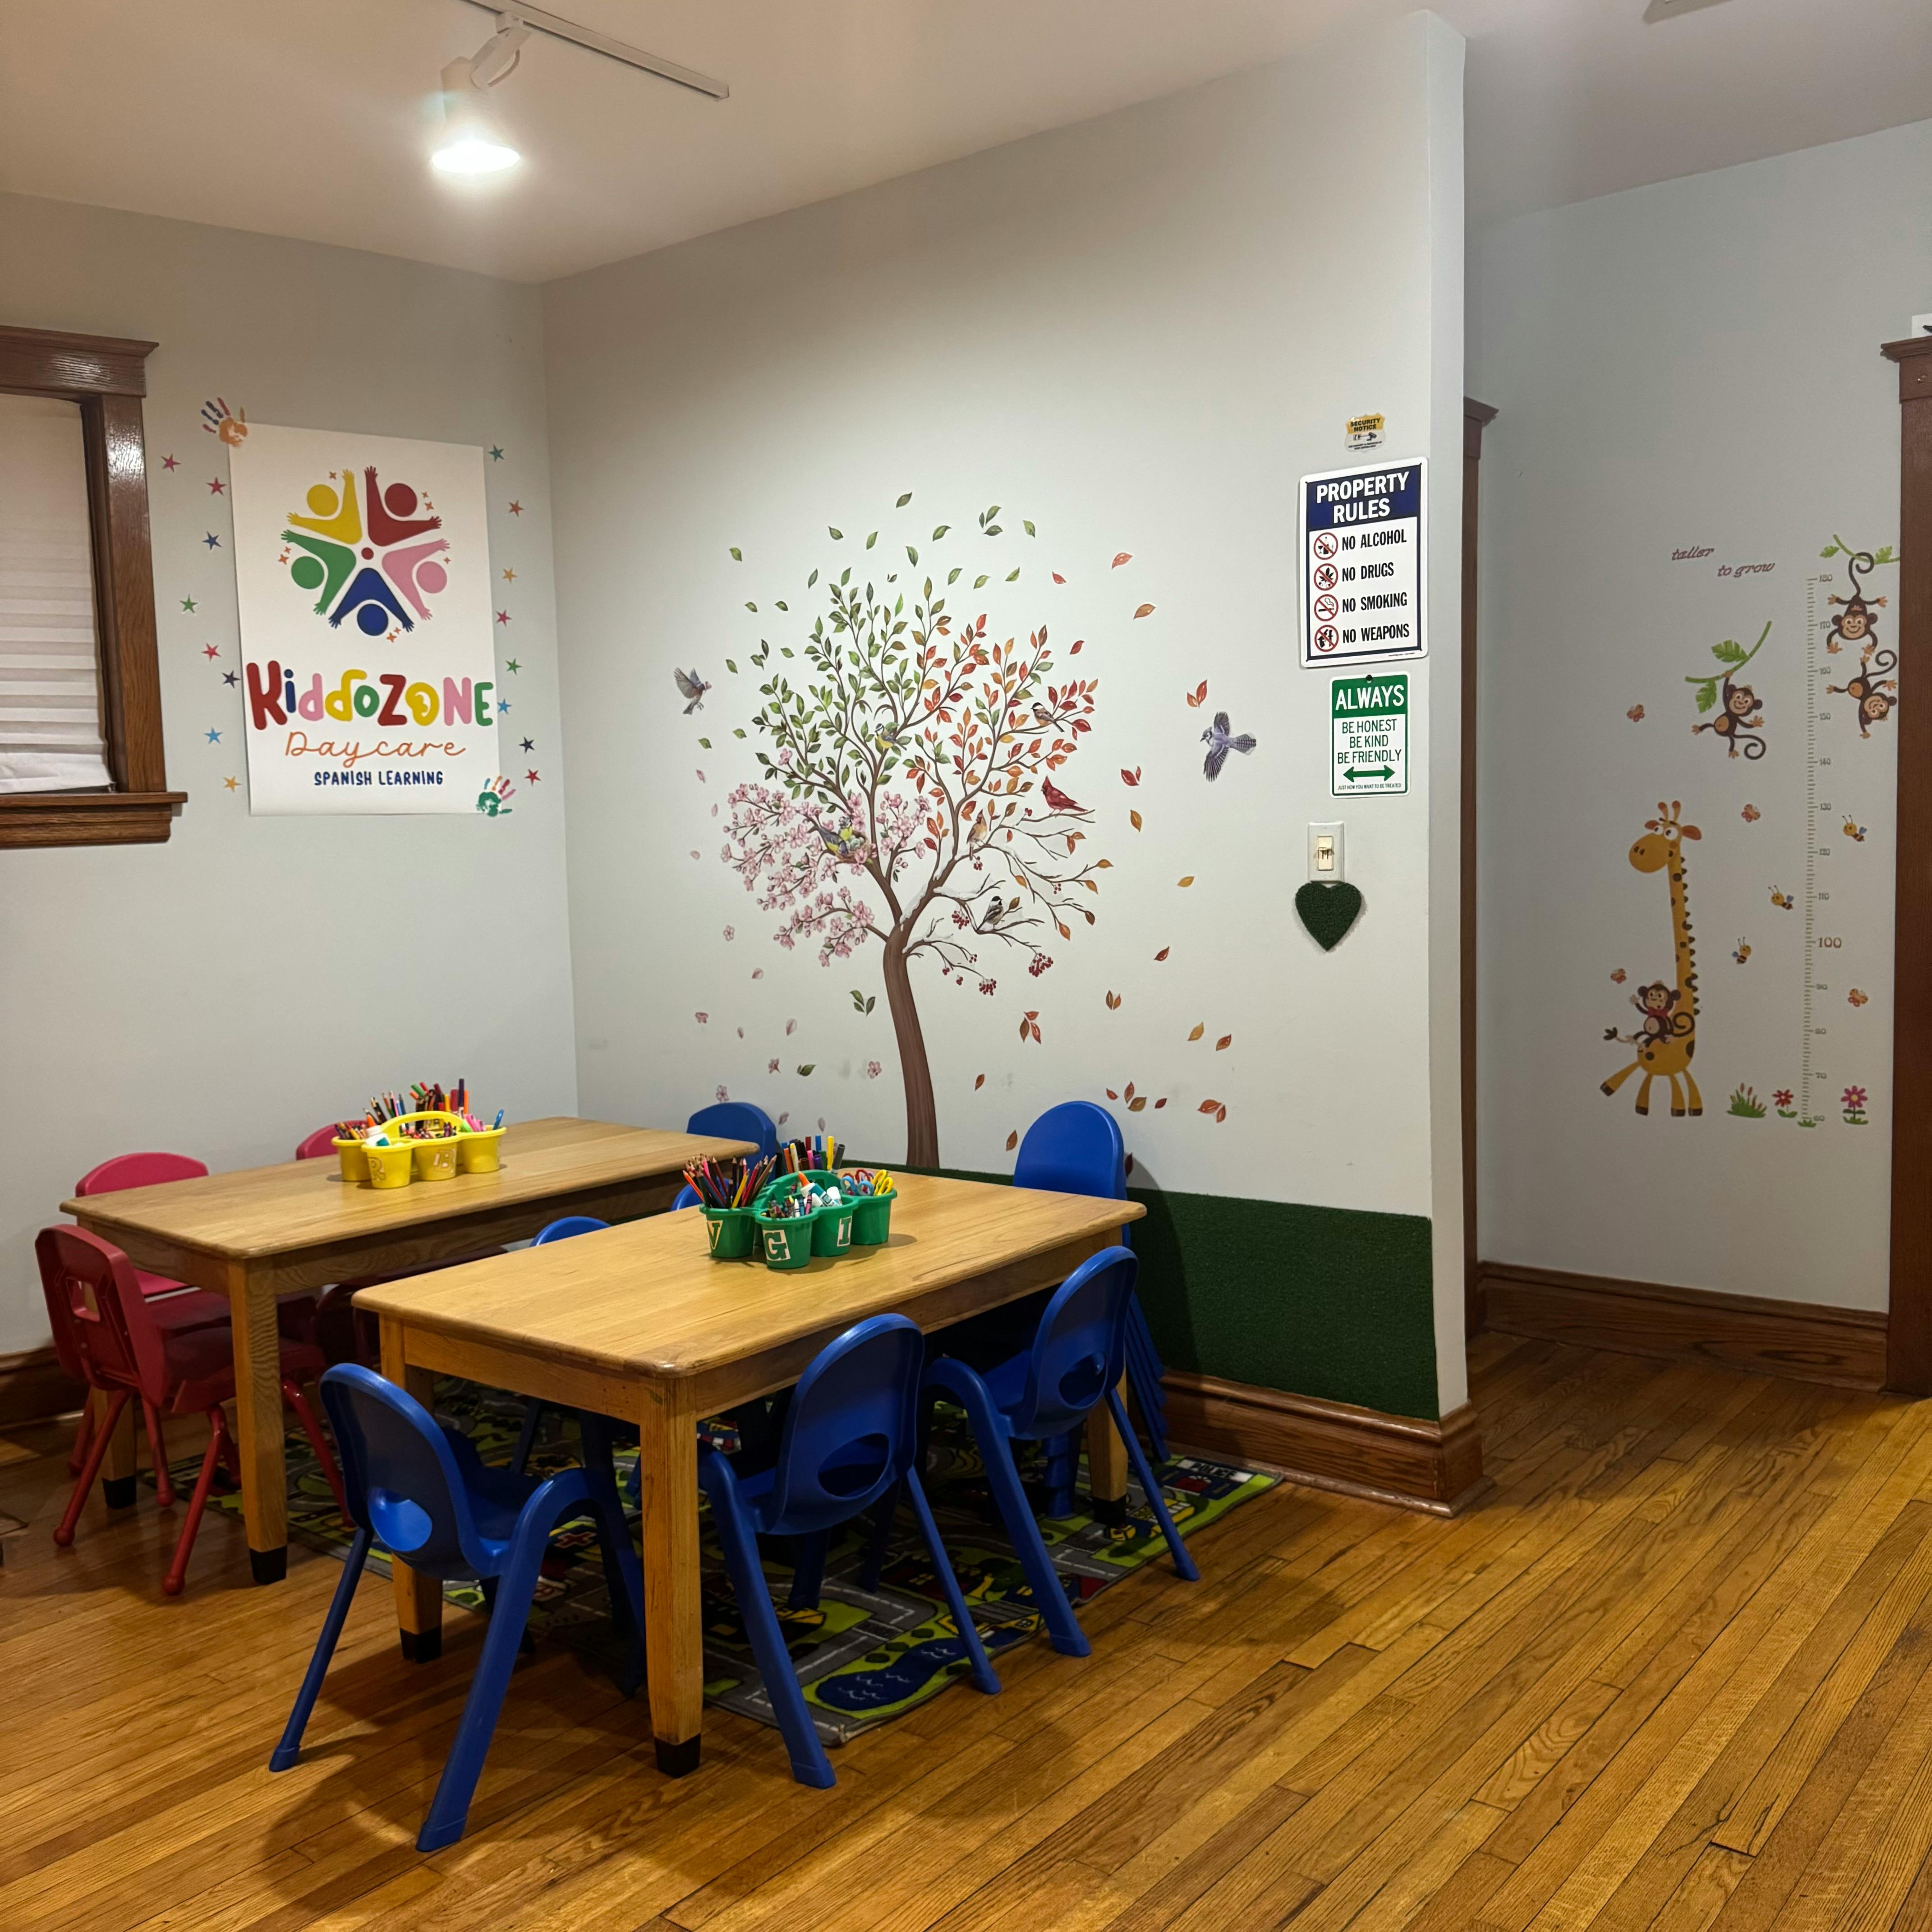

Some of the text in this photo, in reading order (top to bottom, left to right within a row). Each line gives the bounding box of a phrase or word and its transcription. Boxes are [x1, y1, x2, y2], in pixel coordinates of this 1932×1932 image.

[1350, 418, 1380, 427] SECURITY
[1354, 424, 1376, 432] NOTICE
[1316, 471, 1410, 504] PROPERTY
[1333, 497, 1390, 524] RULES
[1342, 529, 1407, 551] NO ALCOHOL
[1672, 546, 1715, 561] taller
[1342, 562, 1394, 582] NO DRUGS
[1717, 563, 1776, 578] to grow
[1819, 574, 1833, 582] 180
[1342, 592, 1408, 613] NO SMOKING
[1820, 621, 1831, 629] 170
[1342, 623, 1410, 644] NO WEAPONS
[1335, 685, 1404, 711] ALWAYS
[1342, 719, 1397, 734] BE HONEST
[285, 731, 467, 768] Daycare
[1350, 735, 1389, 748] BE KIND
[1338, 749, 1402, 764] BE FRIENDLY
[314, 770, 444, 786] SPANISH LEARNING
[1820, 803, 1831, 811] 130
[1818, 937, 1842, 948] 100
[707, 1222, 721, 1248] V
[839, 1218, 851, 1245] I
[764, 1232, 787, 1260] G
